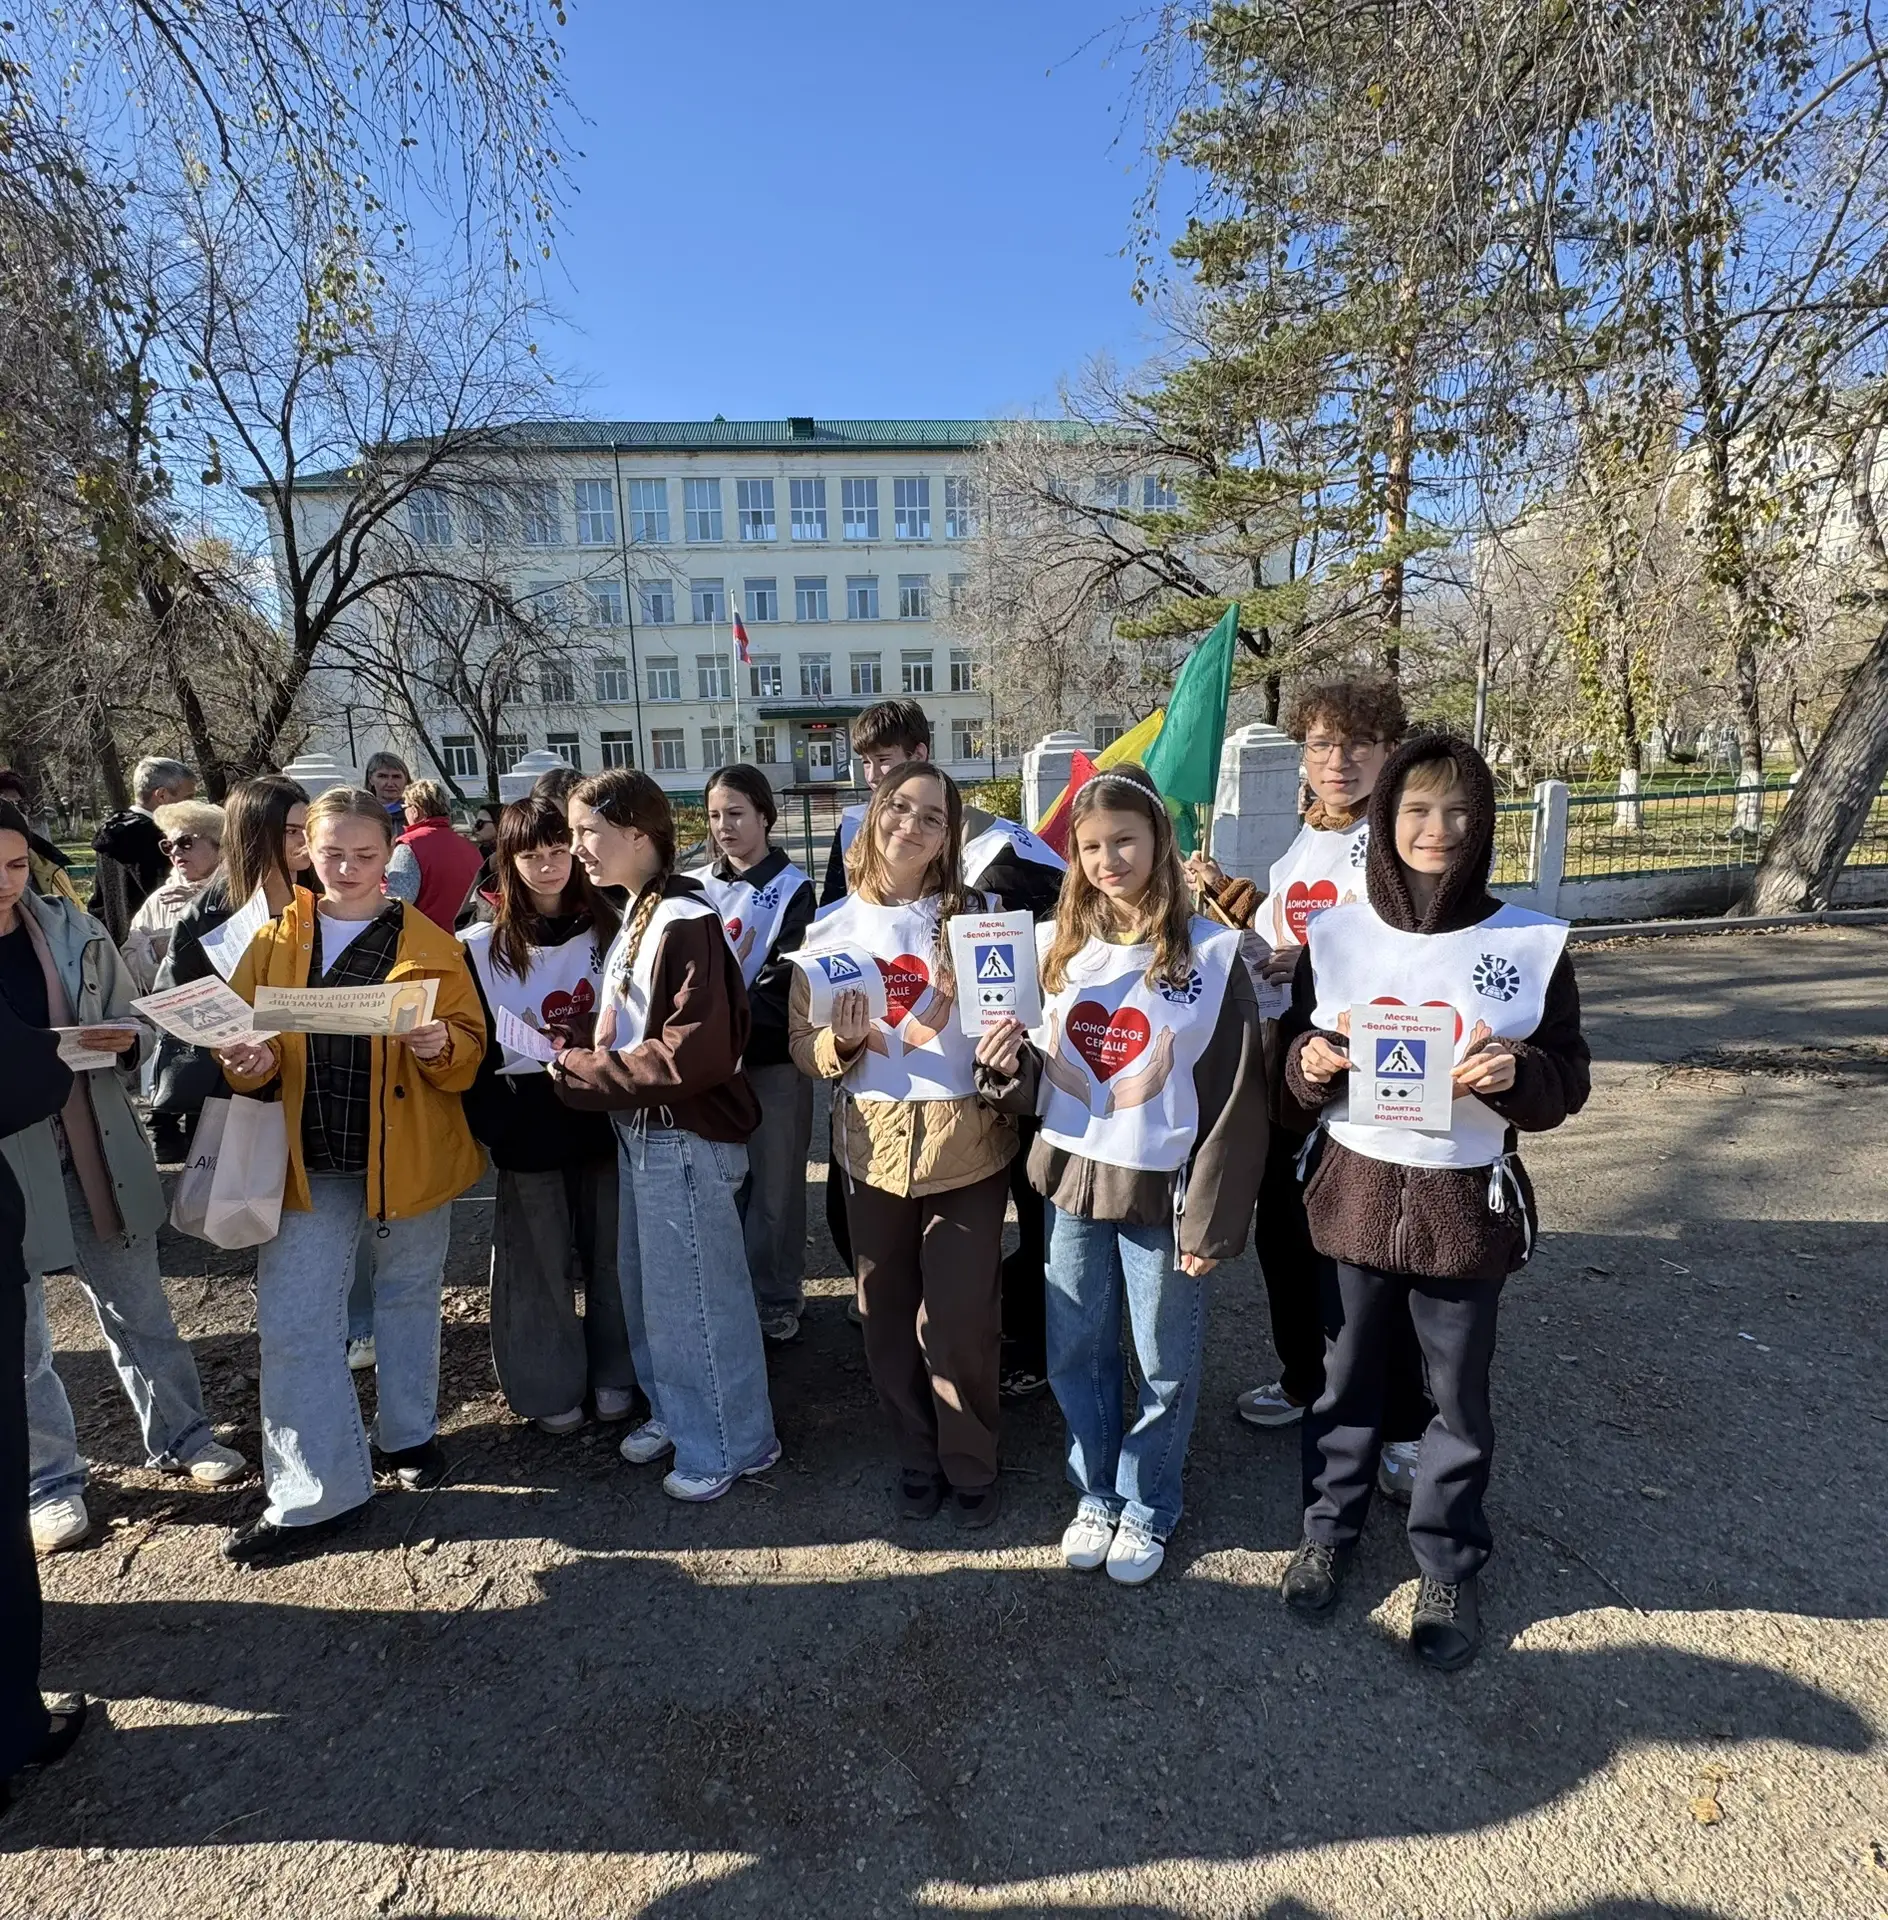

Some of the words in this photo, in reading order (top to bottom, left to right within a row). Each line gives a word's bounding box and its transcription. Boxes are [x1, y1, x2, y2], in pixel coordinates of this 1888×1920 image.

[1286, 899, 1334, 909] ДОНОРСКОЕ
[1292, 911, 1308, 921] СЕР
[979, 921, 1005, 929] Месяц
[881, 973, 923, 984] ОРСКОЕ
[1384, 1013, 1418, 1022] Месяц
[1072, 1020, 1144, 1042] ДОНОРСКОЕ
[1361, 1022, 1398, 1031] «Белой
[1401, 1024, 1442, 1033] трости»
[1085, 1036, 1128, 1053] СЕРДЦЕ
[1377, 1103, 1421, 1113] Памятка
[1374, 1113, 1424, 1122] водителю
